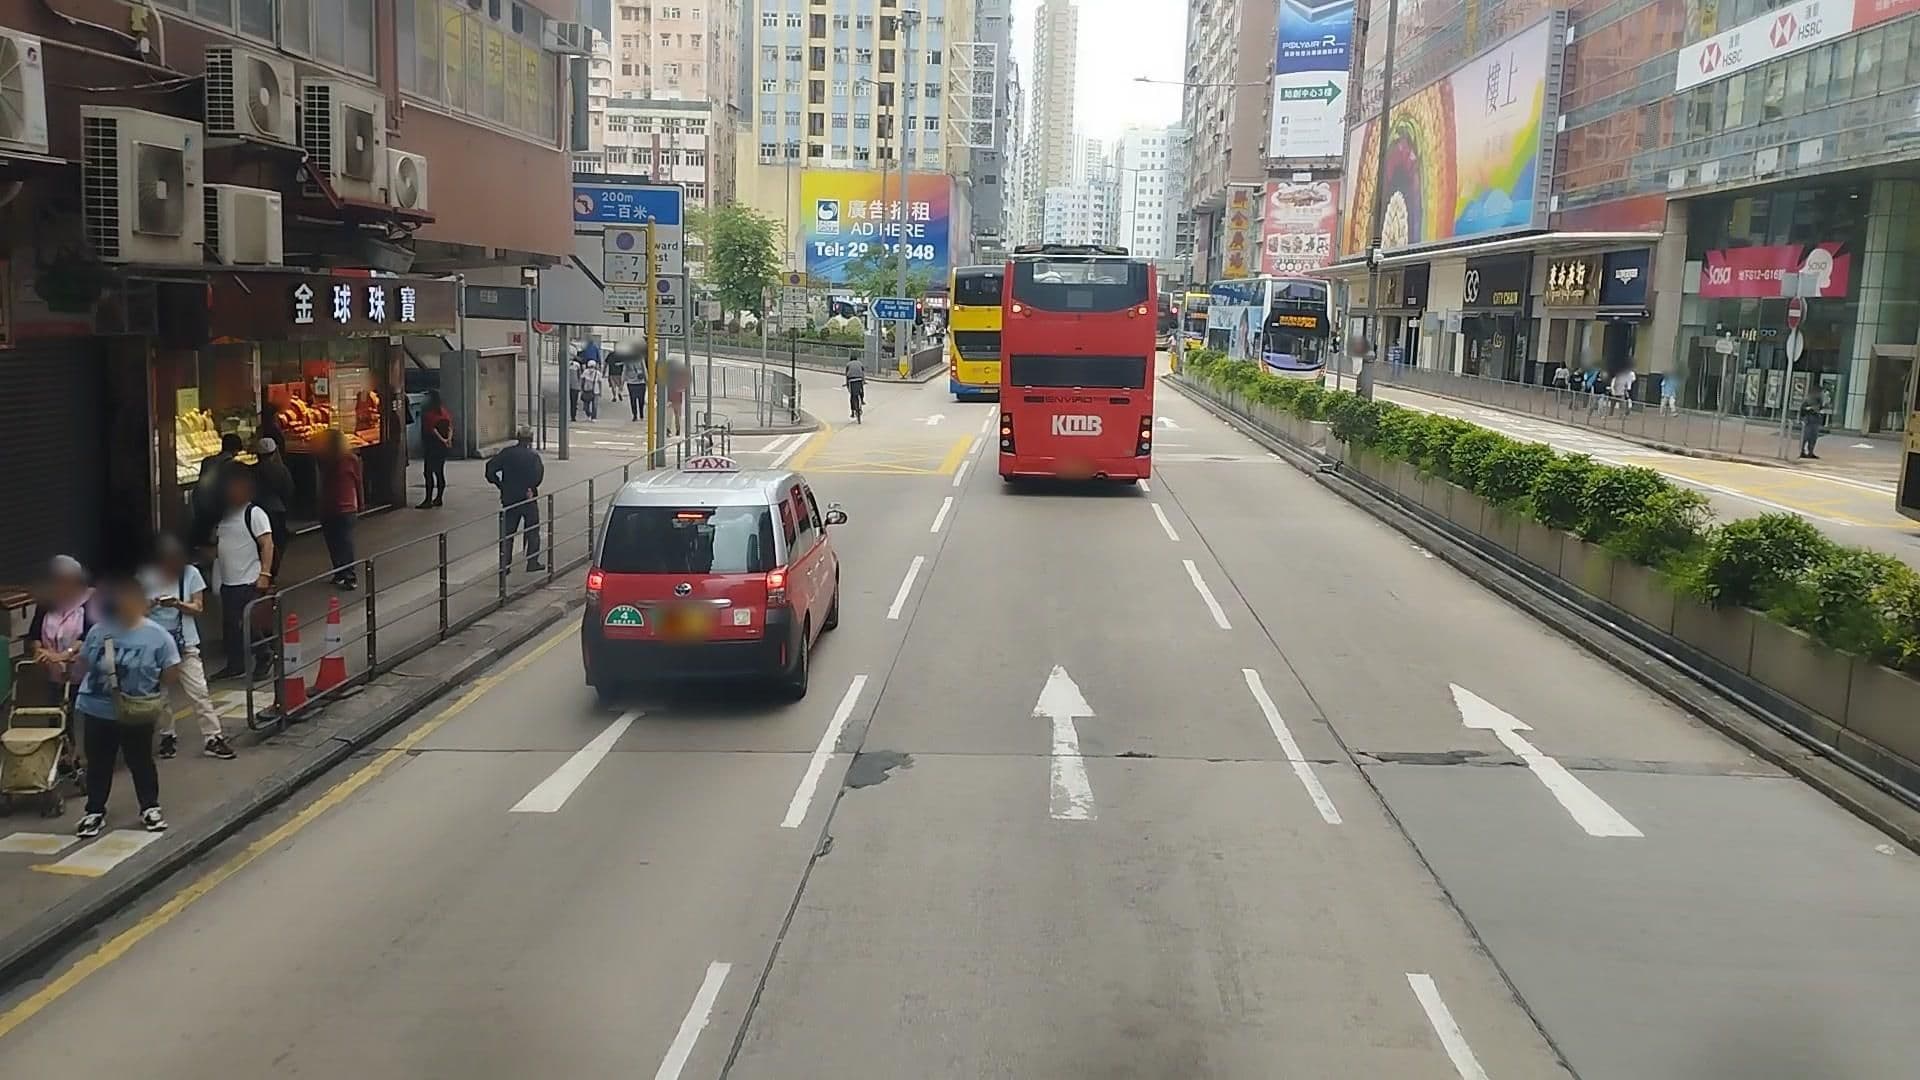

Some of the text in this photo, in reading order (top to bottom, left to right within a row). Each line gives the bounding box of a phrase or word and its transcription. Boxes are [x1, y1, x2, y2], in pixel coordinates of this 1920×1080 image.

[1797, 19, 1823, 40] HSBC
[1322, 34, 1336, 47] R
[1722, 48, 1743, 68] HSBC
[1485, 51, 1518, 117] 樓上
[601, 191, 634, 203] 200m
[602, 204, 647, 220] 二百米
[850, 222, 873, 236] AD
[879, 223, 925, 238] HERE
[815, 242, 845, 257] Tel:
[631, 256, 639, 266] 7
[631, 271, 639, 281] 7
[294, 283, 416, 324] 金球珠寶
[669, 324, 681, 333] 12
[1051, 414, 1103, 436] KMB
[691, 457, 731, 469] TAXI
[620, 611, 629, 620] 4
